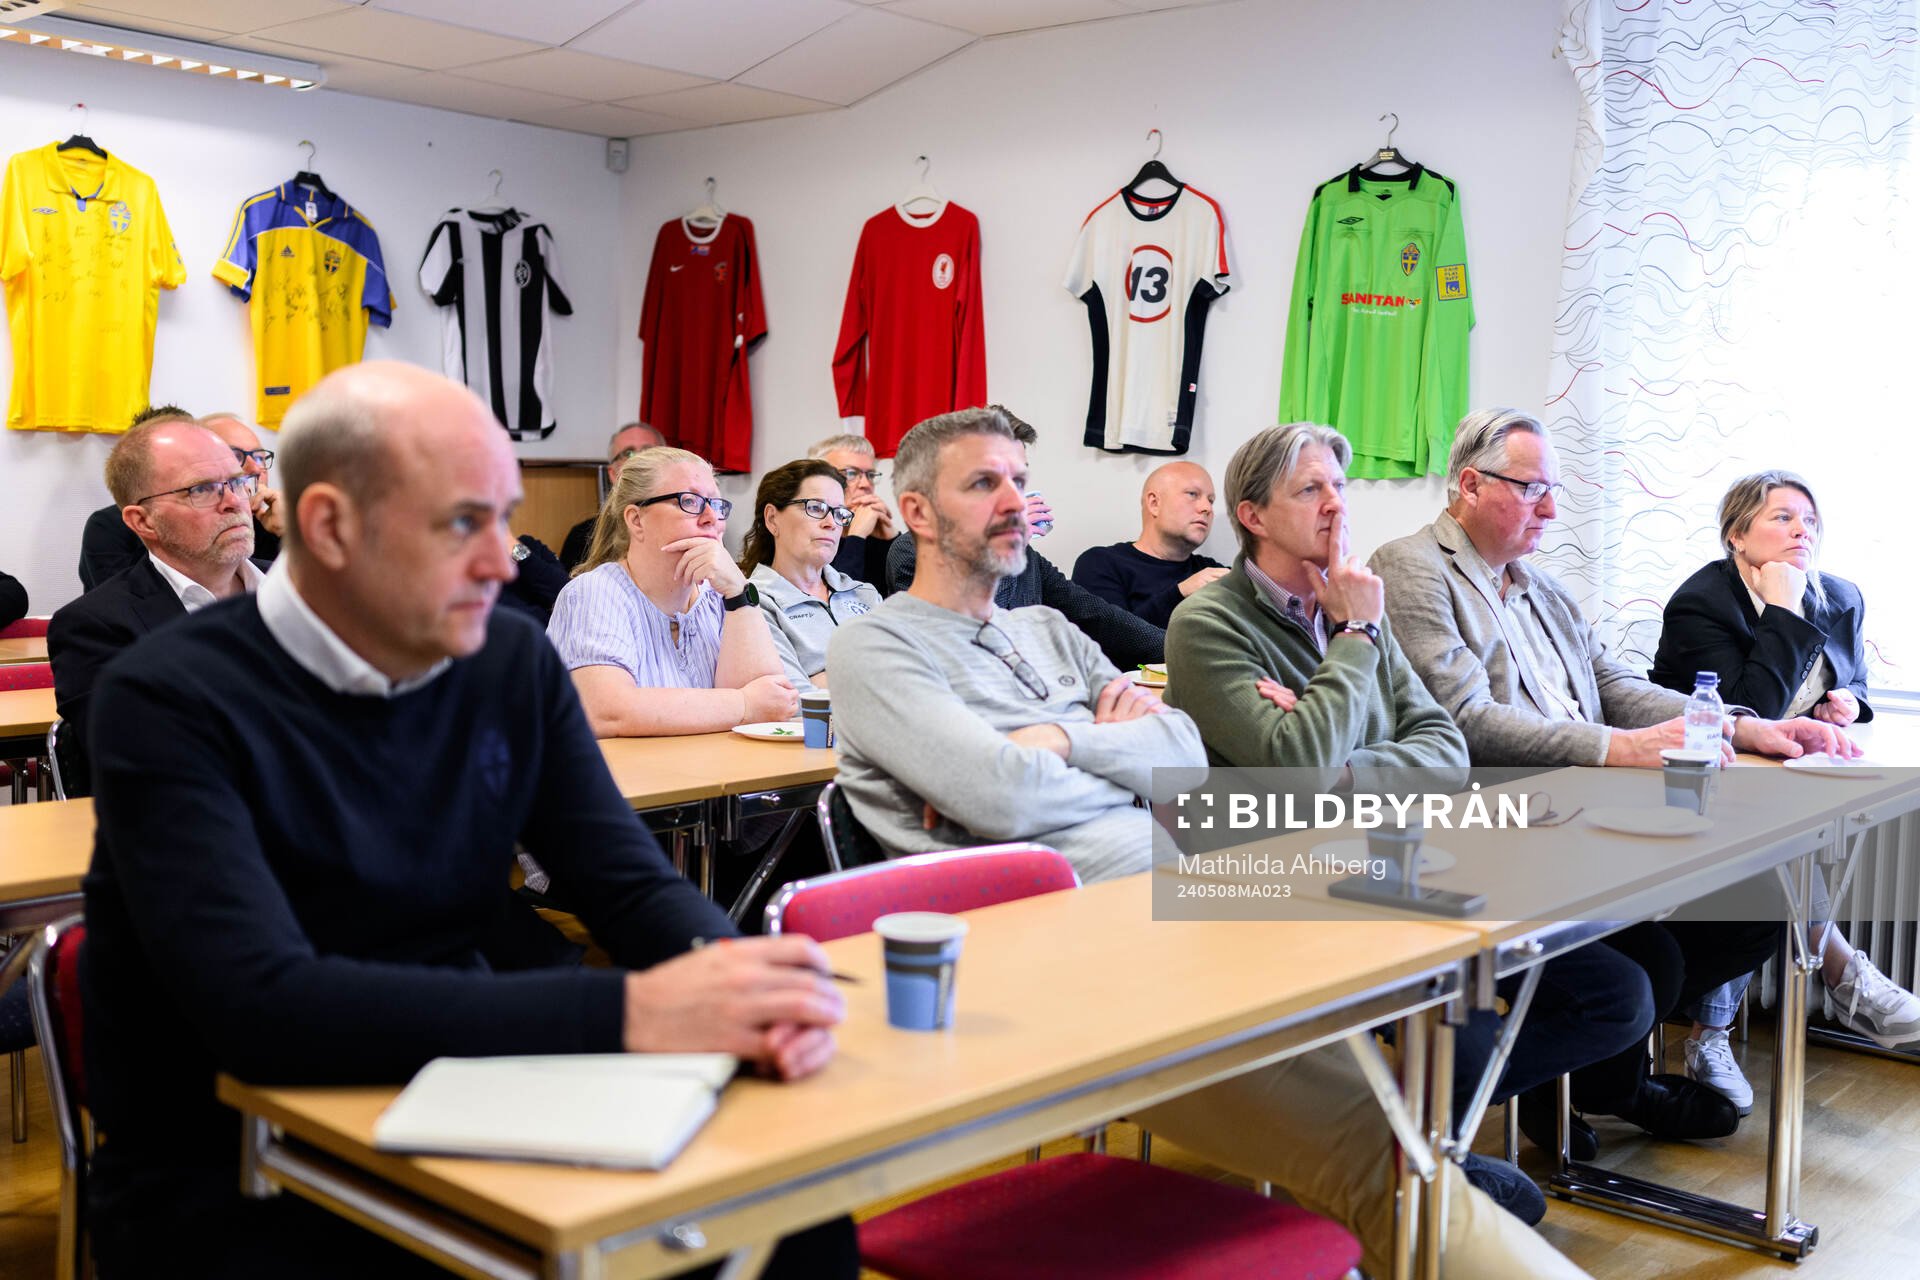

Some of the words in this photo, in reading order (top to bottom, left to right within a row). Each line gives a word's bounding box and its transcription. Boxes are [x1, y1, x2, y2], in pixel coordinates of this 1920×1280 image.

[1129, 266, 1169, 303] 13
[1341, 293, 1405, 307] SANITAN
[788, 613, 809, 621] CRAFT
